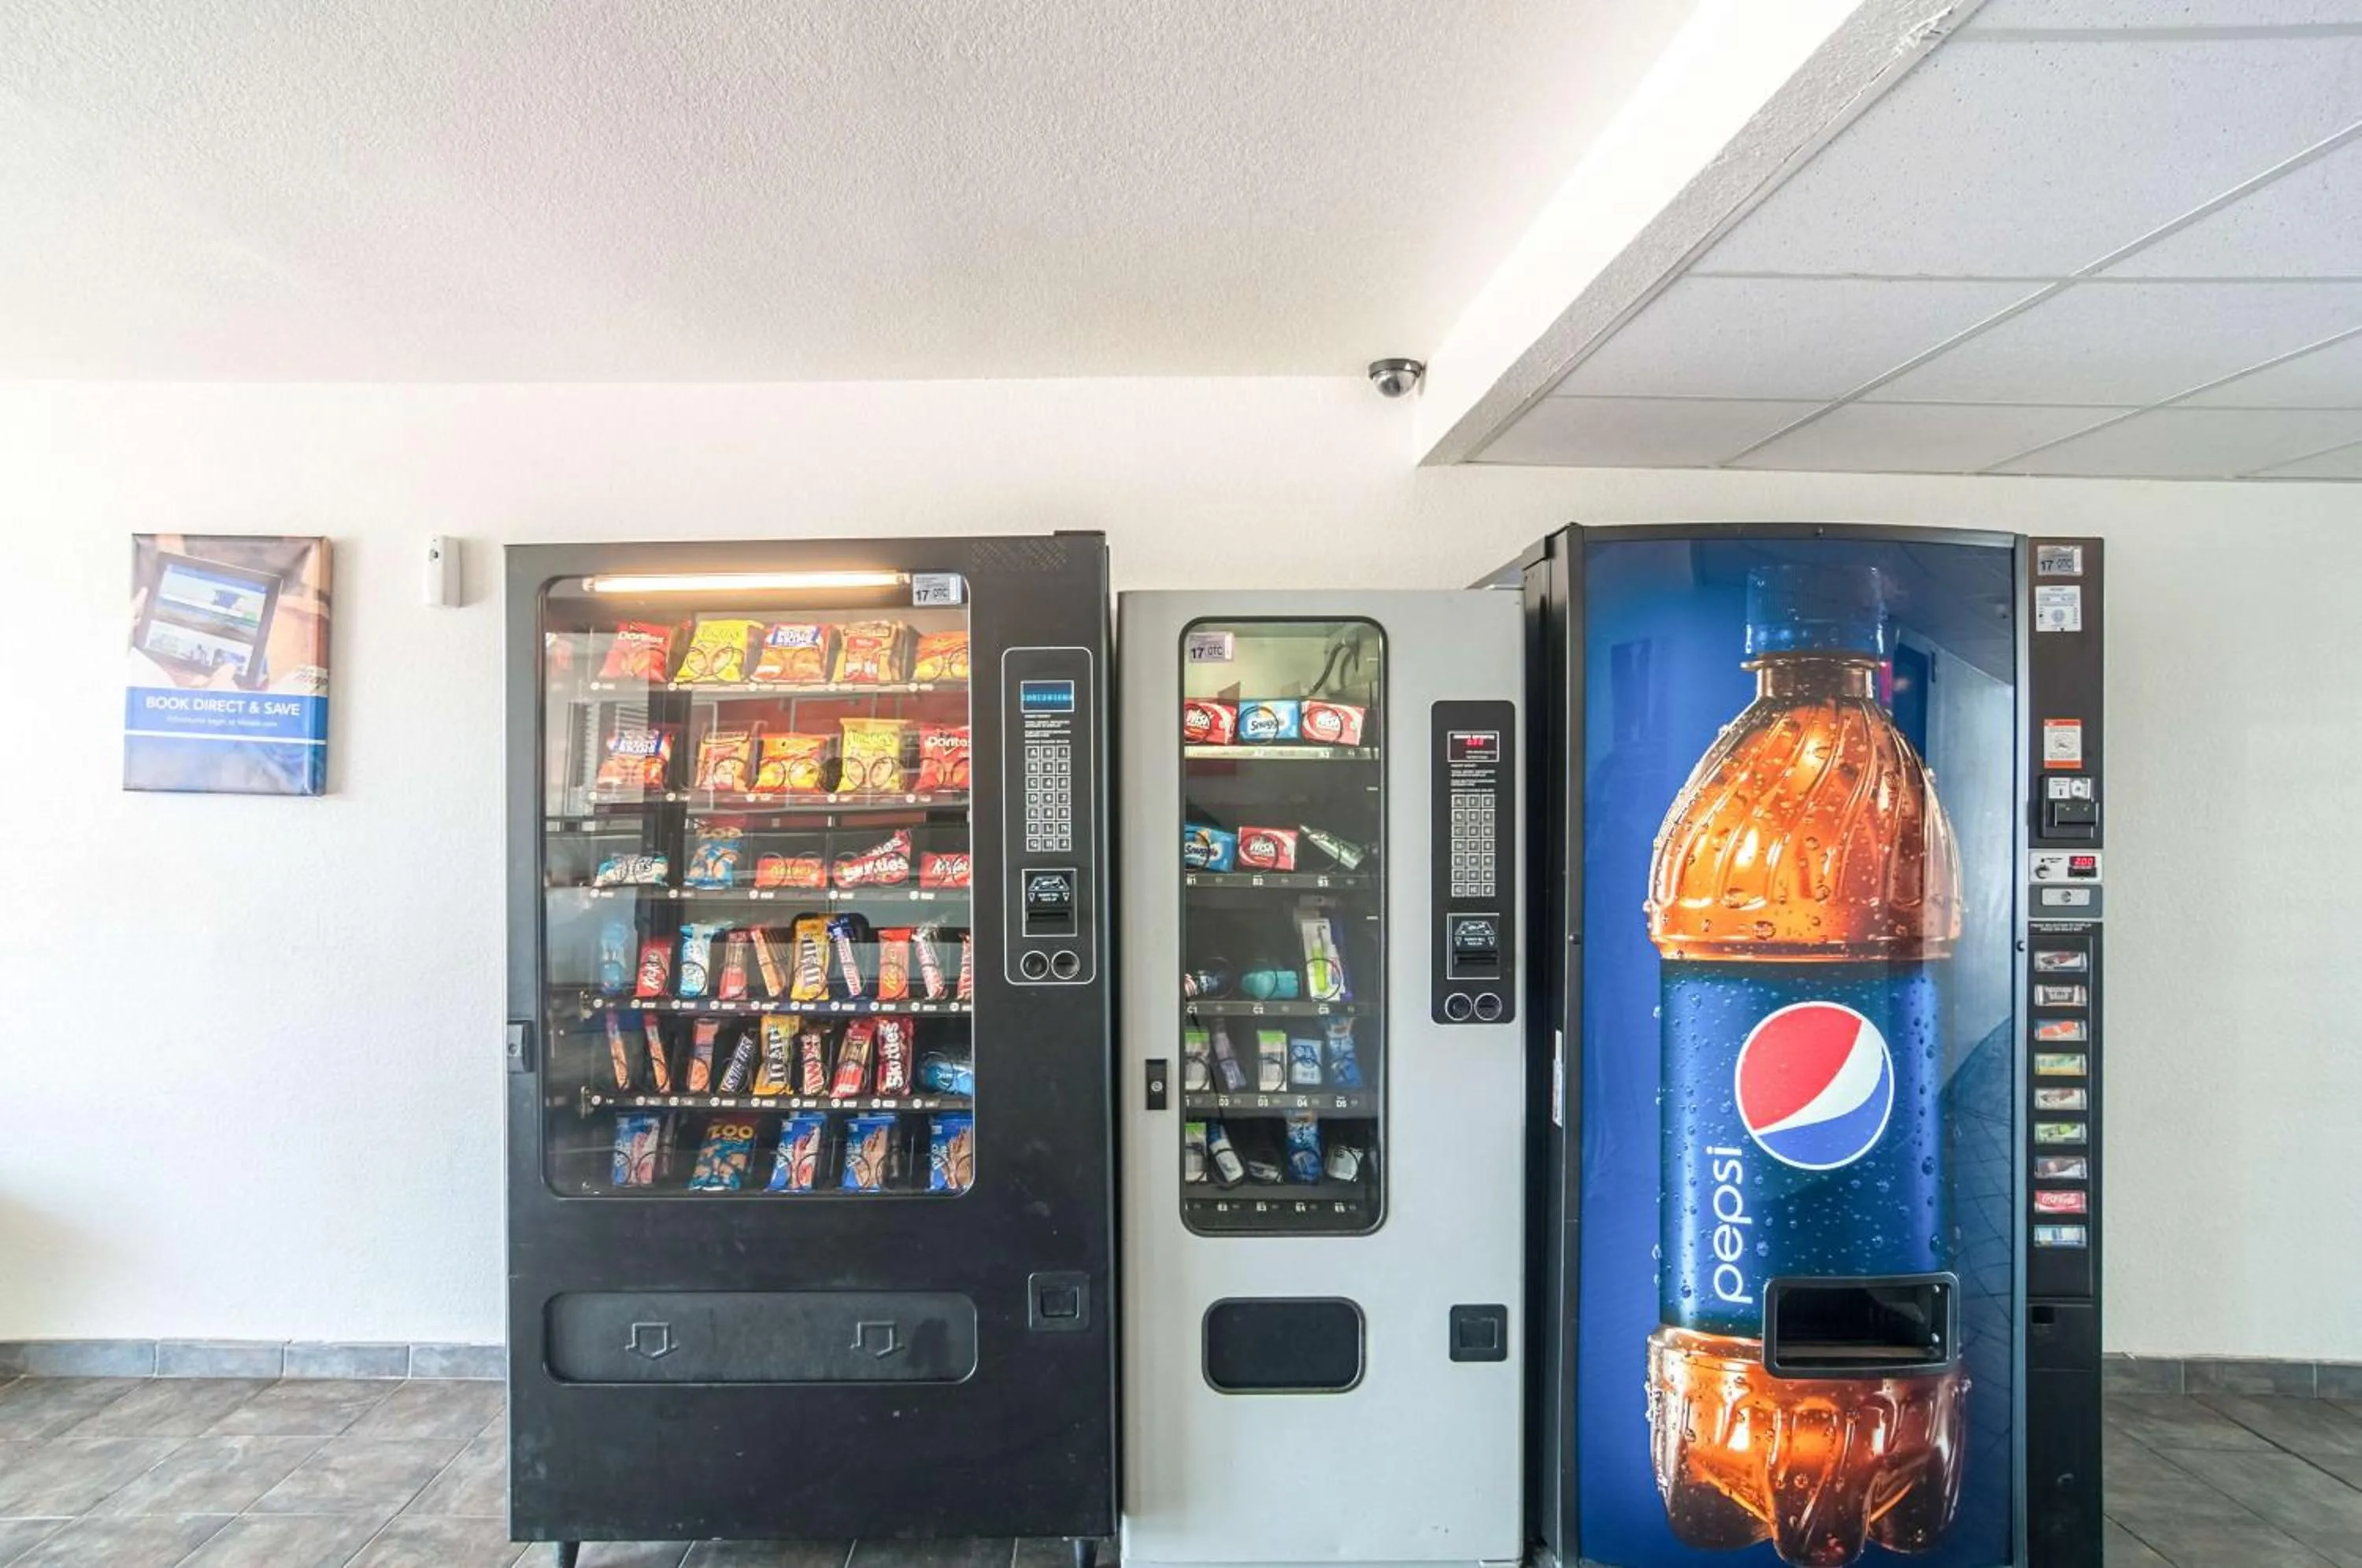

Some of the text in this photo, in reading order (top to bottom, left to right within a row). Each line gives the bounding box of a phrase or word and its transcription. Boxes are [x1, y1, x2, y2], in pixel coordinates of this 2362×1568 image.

[2041, 560, 2053, 571] 17
[916, 590, 929, 602] 17
[1190, 647, 1204, 659] 17
[146, 696, 301, 716] BOOK DIRECT & SAVE
[724, 1036, 753, 1089] SNICKERS
[883, 1021, 904, 1089] Skittles
[1706, 1145, 1753, 1304] pepsi
